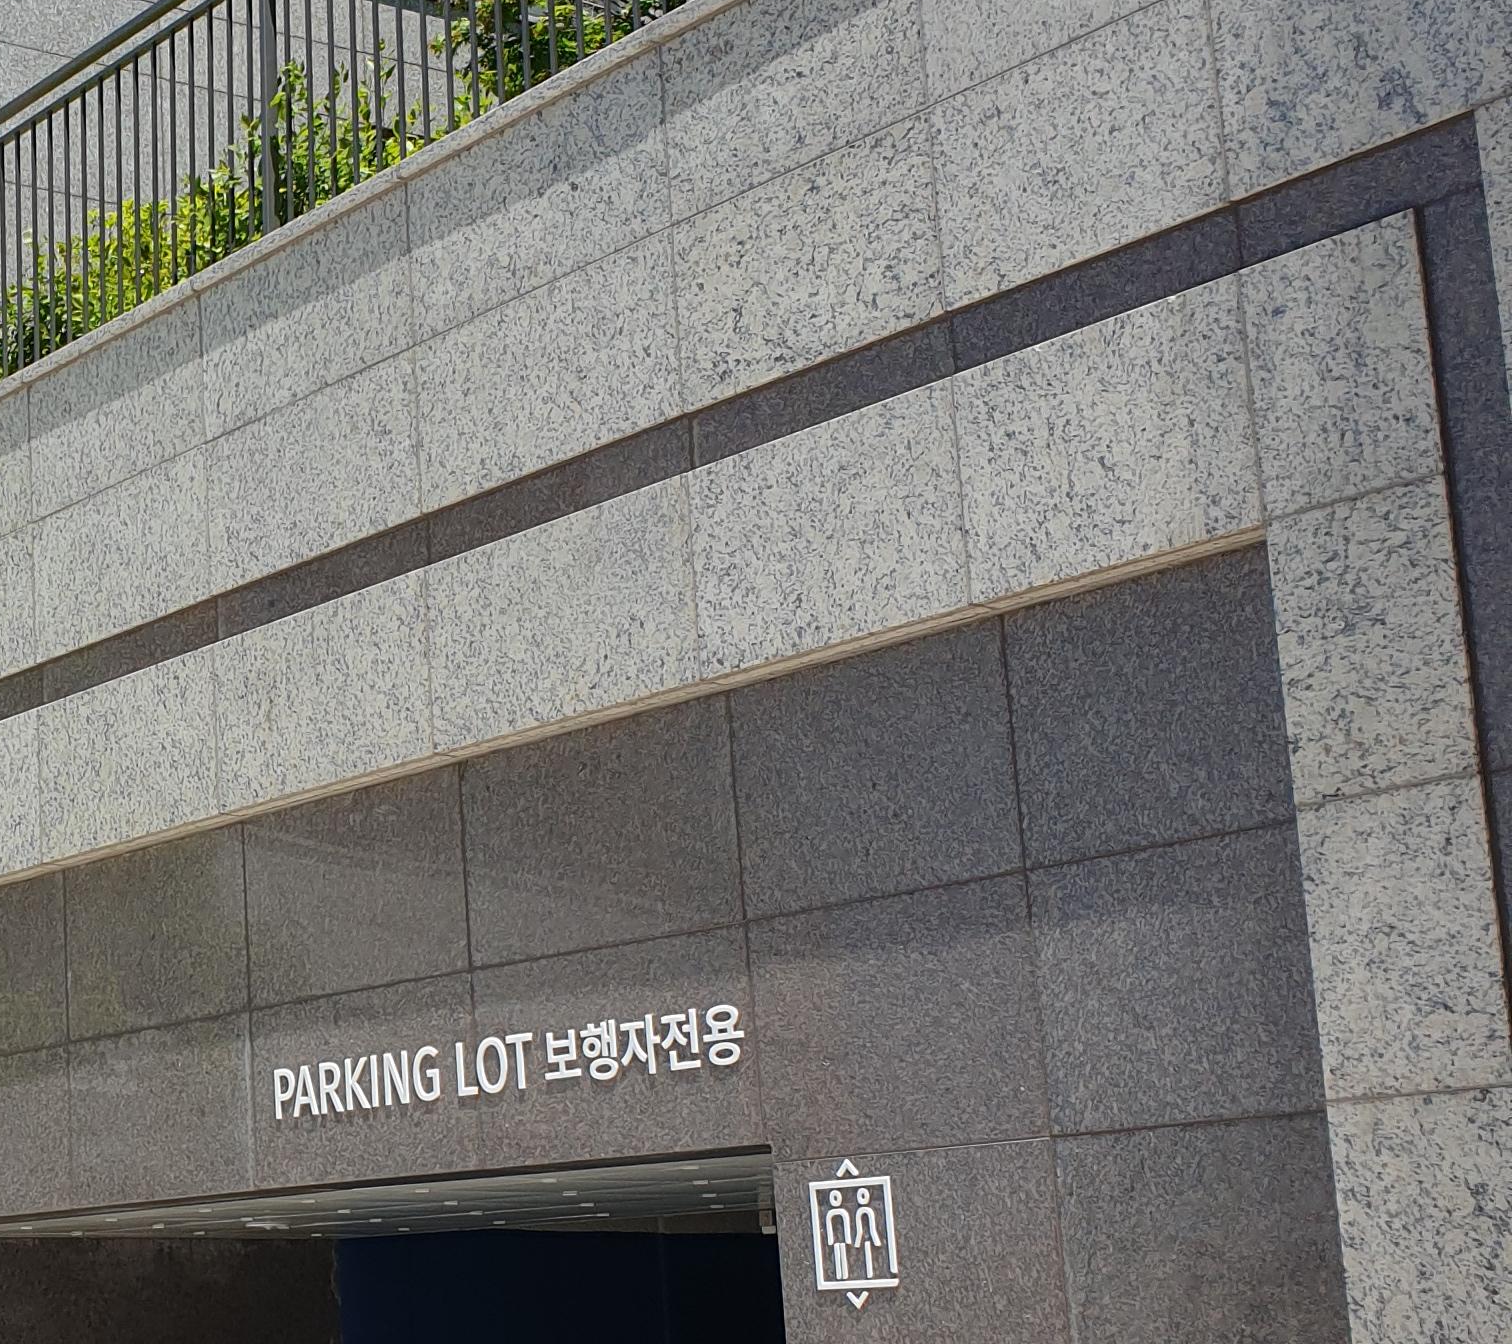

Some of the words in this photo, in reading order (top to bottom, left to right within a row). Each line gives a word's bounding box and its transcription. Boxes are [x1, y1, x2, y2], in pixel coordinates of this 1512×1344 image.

[273, 1045, 441, 1120] PARKING
[455, 1031, 534, 1096] LOT
[544, 1004, 745, 1081] 보행자전용
